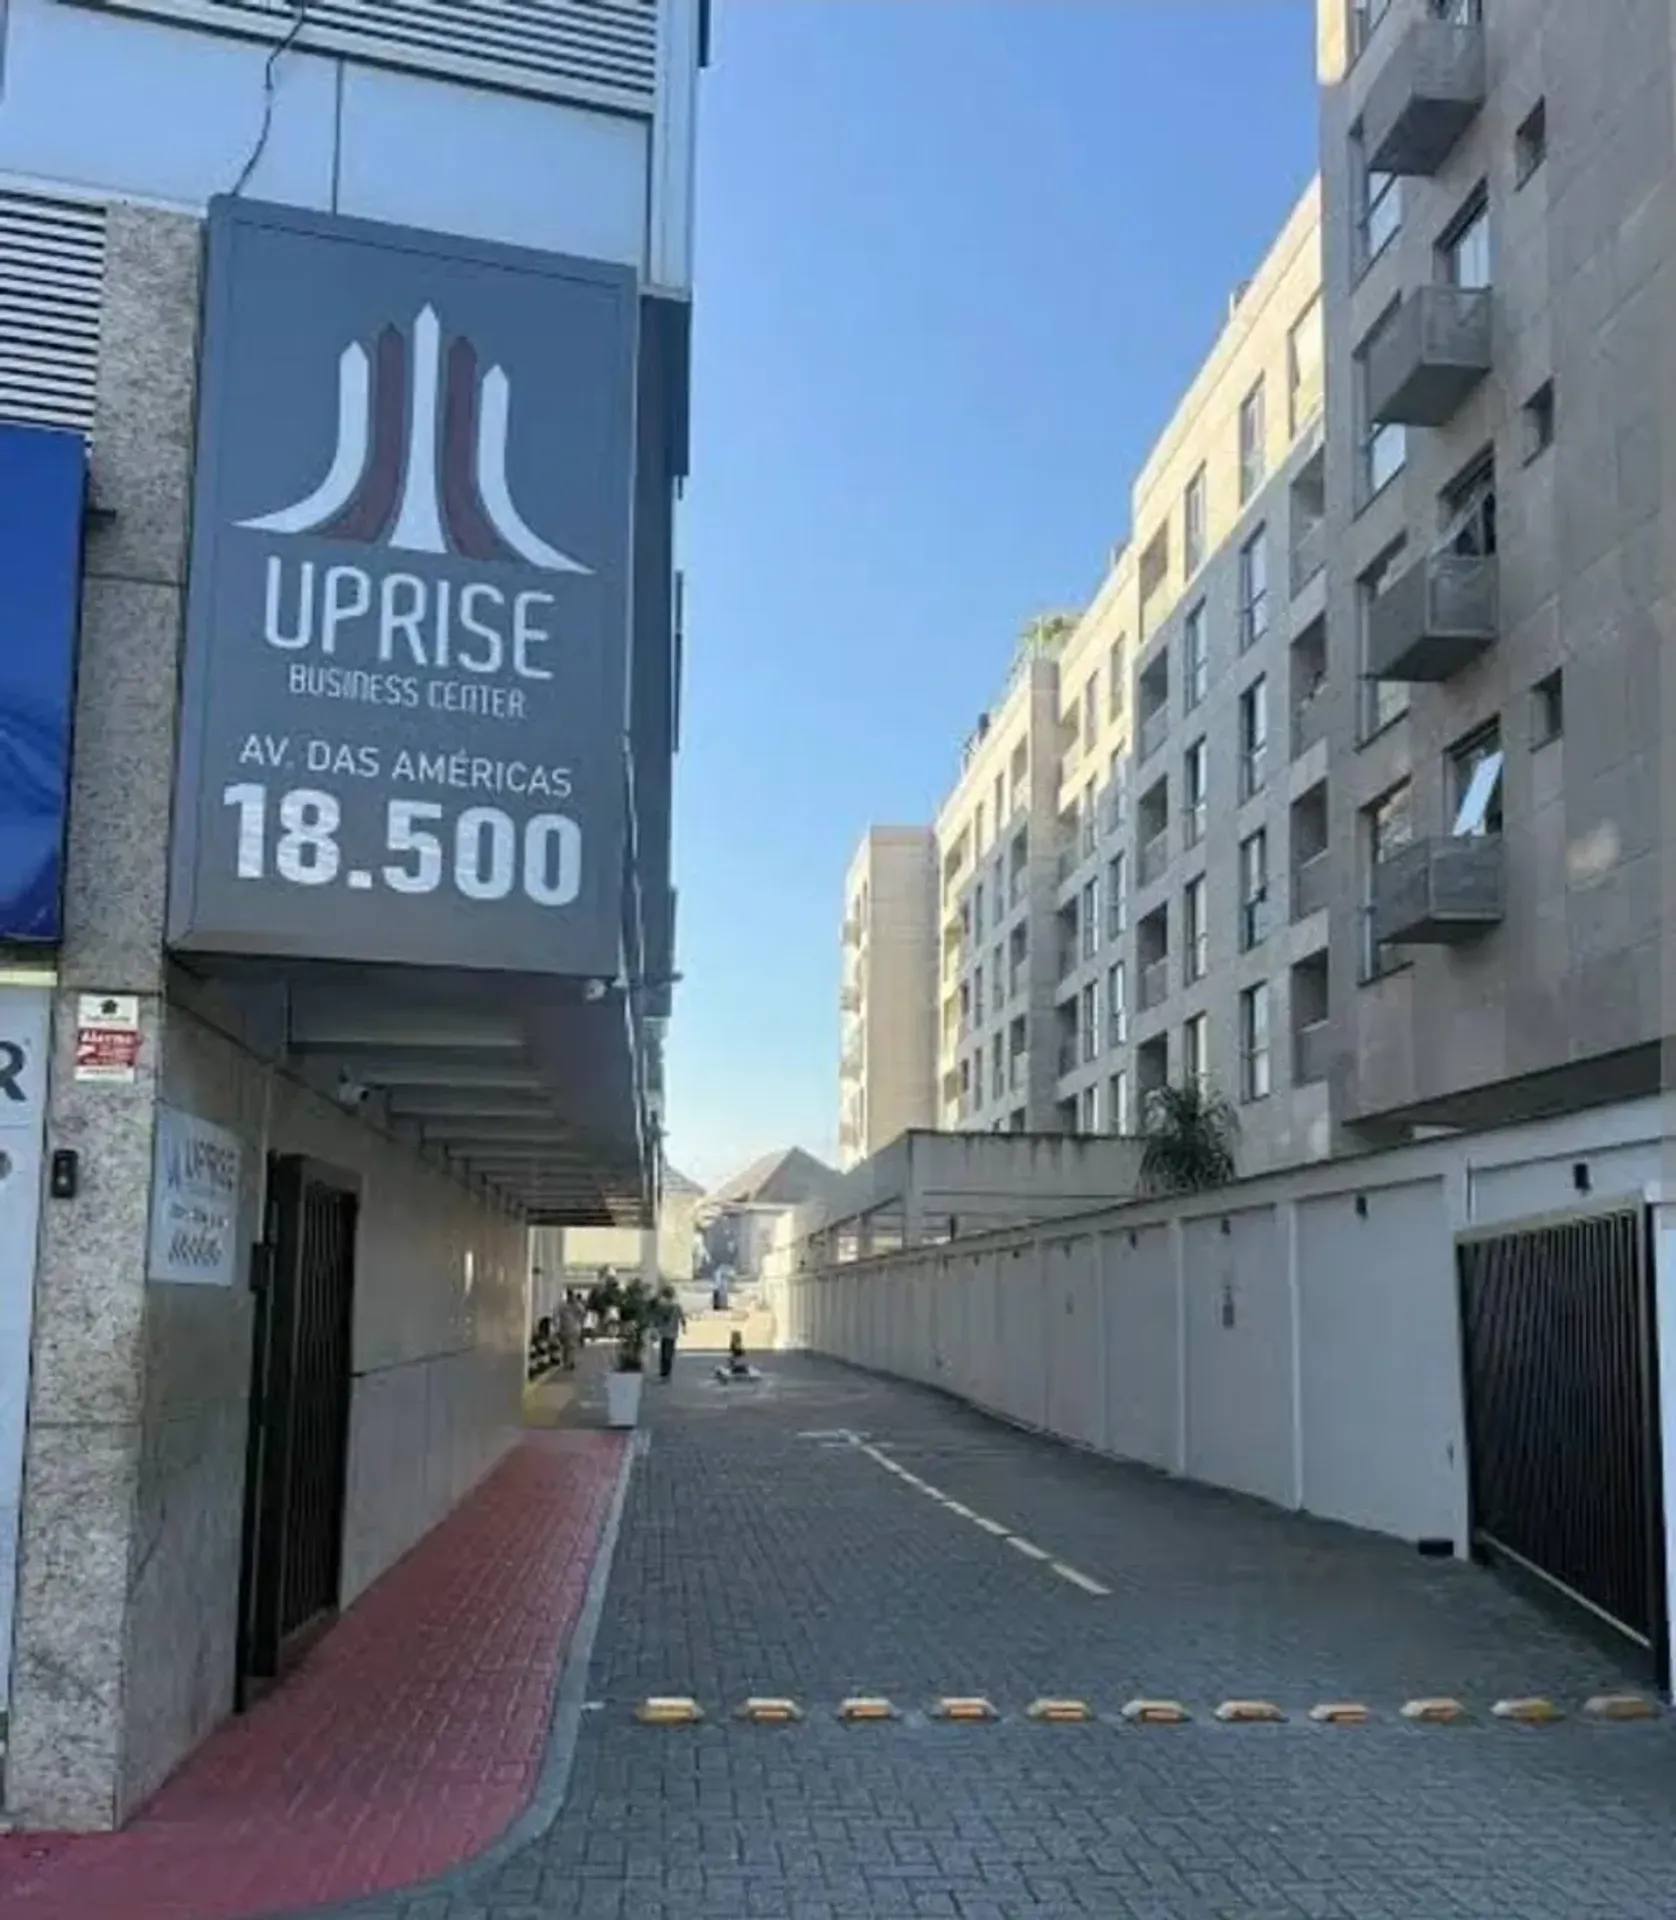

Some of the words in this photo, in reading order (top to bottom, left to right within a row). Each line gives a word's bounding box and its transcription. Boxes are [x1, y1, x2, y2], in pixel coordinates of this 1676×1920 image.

[264, 555, 555, 680] UPRISE
[290, 664, 419, 707] BUSINESS
[427, 681, 526, 719] CENTER
[239, 734, 294, 767] AV.
[307, 740, 380, 778] DAS
[391, 749, 573, 798] AMÉRICAS
[223, 782, 581, 906] 18.500
